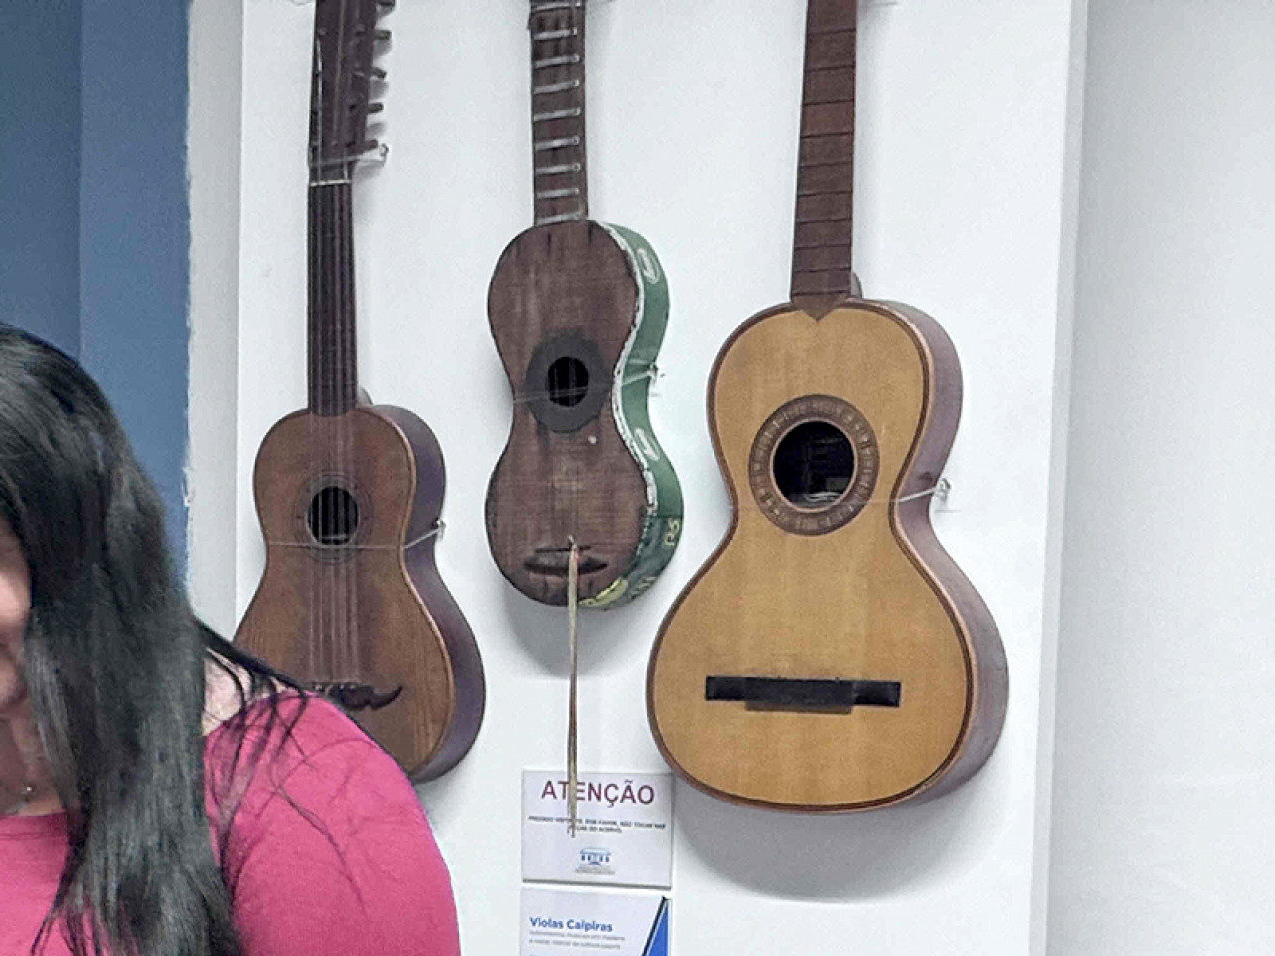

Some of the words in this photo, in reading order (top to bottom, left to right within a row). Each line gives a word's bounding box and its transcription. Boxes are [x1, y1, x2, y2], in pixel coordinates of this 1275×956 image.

[541, 779, 655, 808] ATENÇÃO
[529, 917, 564, 930] Violas
[566, 918, 613, 932] Caipiras
